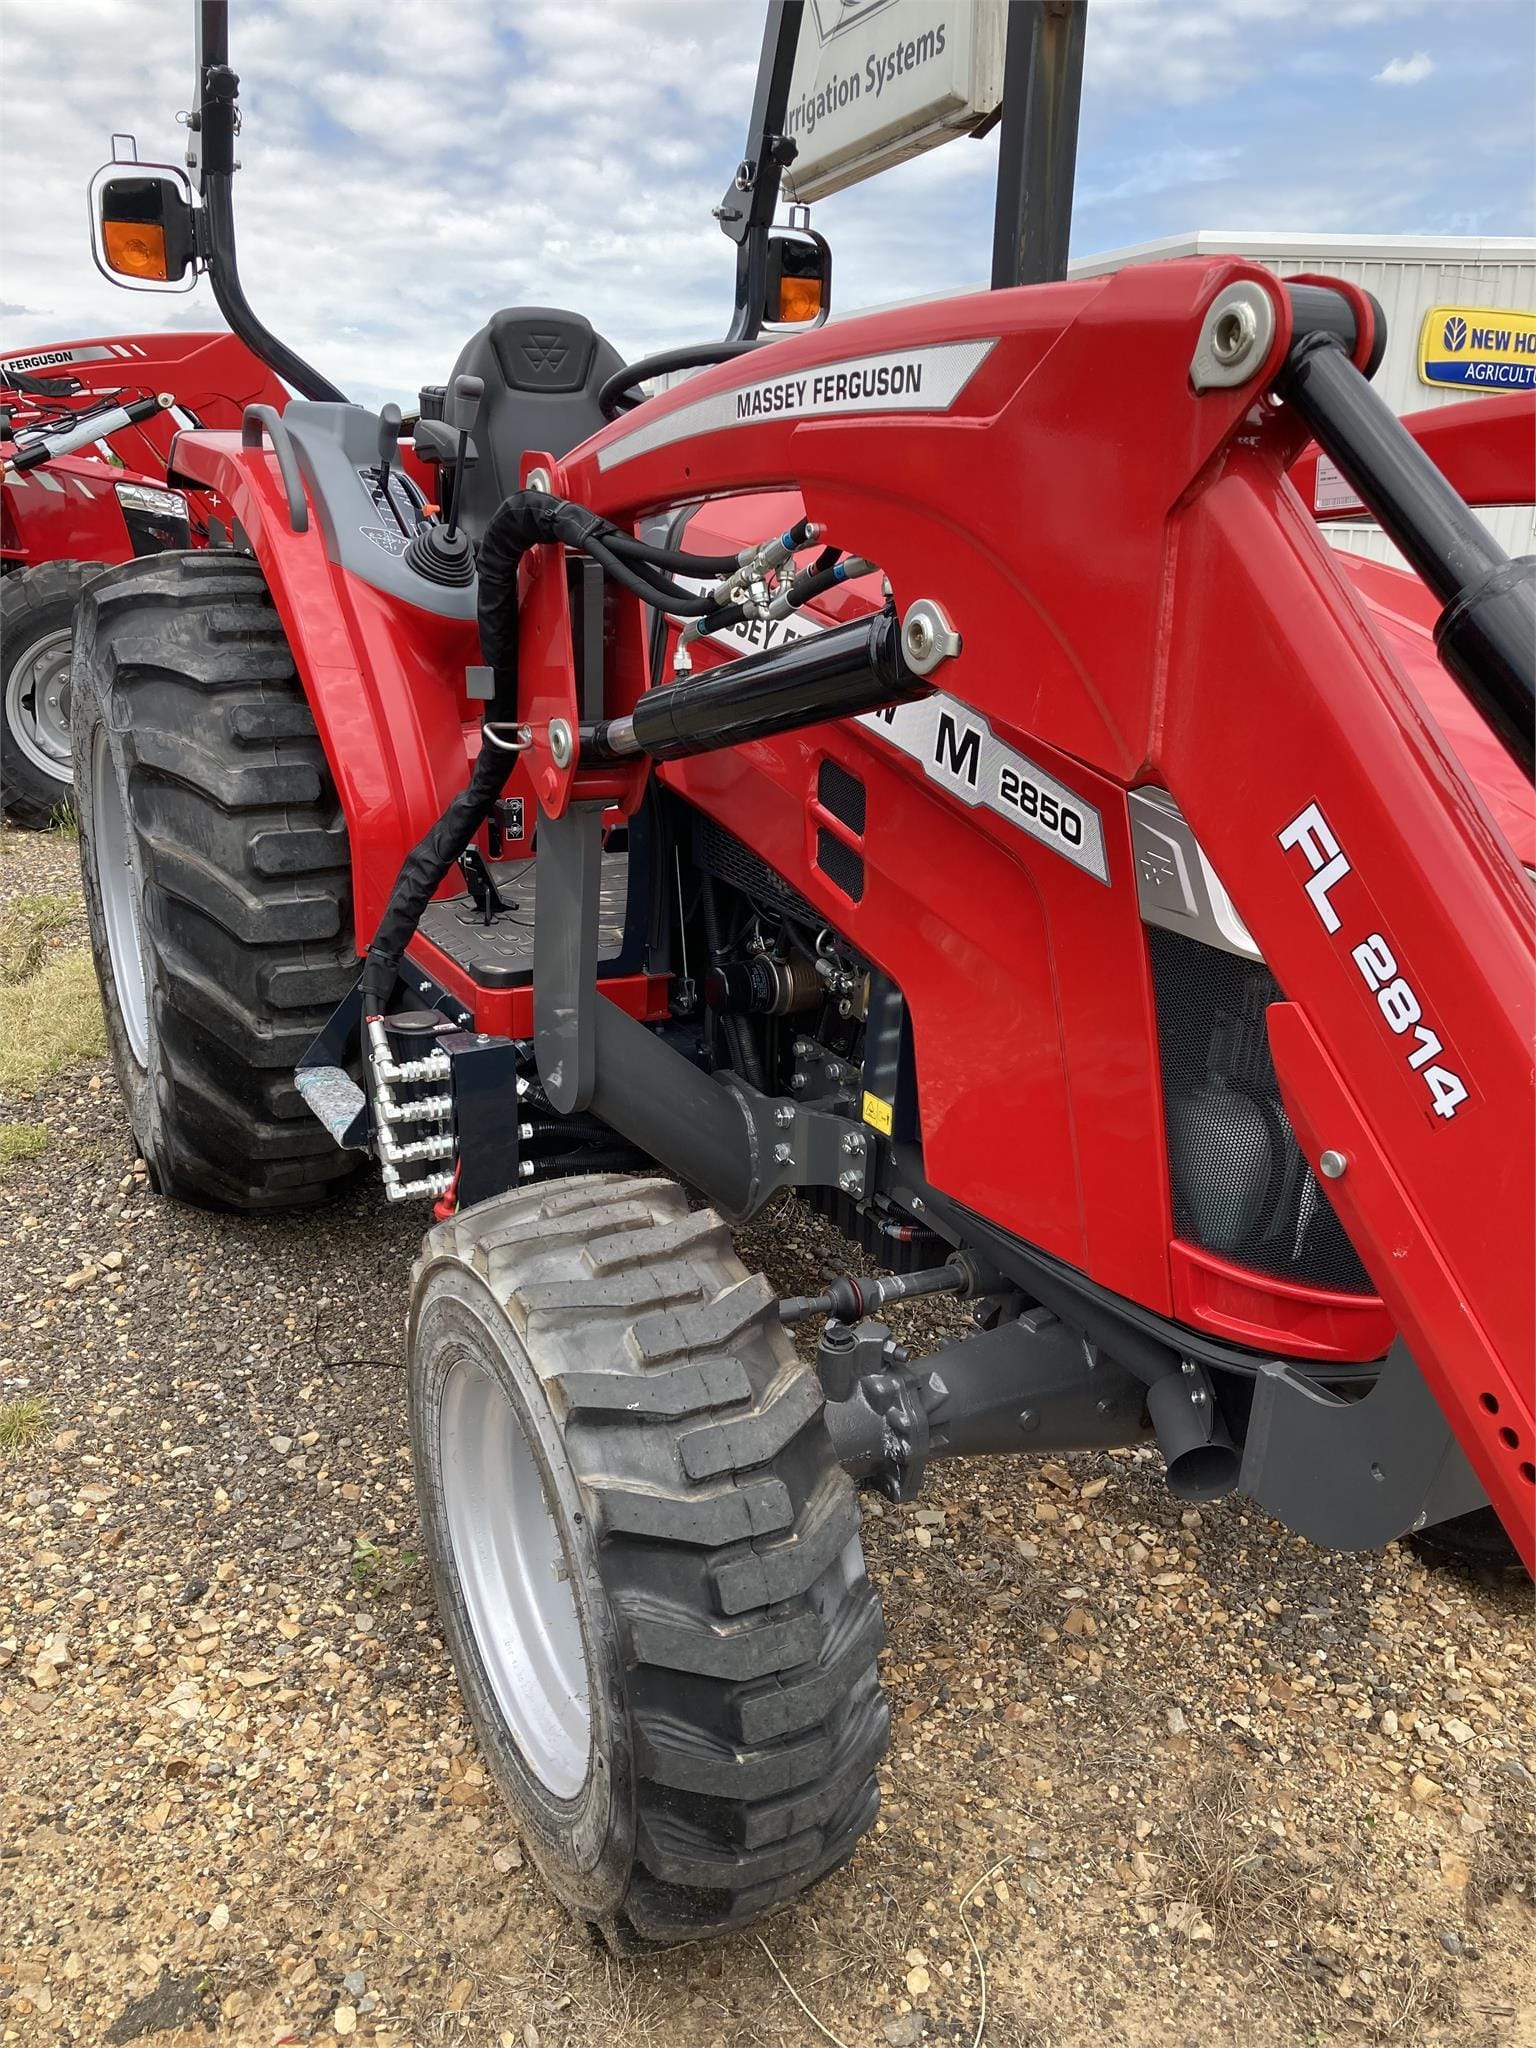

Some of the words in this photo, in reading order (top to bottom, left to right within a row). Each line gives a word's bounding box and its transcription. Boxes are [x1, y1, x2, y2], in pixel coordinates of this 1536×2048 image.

[784, 72, 860, 137] Irrigation
[865, 23, 946, 98] Systems
[9, 351, 74, 371] FERGUSON
[1470, 328, 1511, 352] NEW
[736, 380, 806, 419] MASSEY
[812, 363, 923, 405] FERGUSON
[934, 711, 981, 786] M
[1000, 768, 1082, 846] 2850
[1277, 802, 1352, 935] FL
[1351, 932, 1471, 1120] 2814
